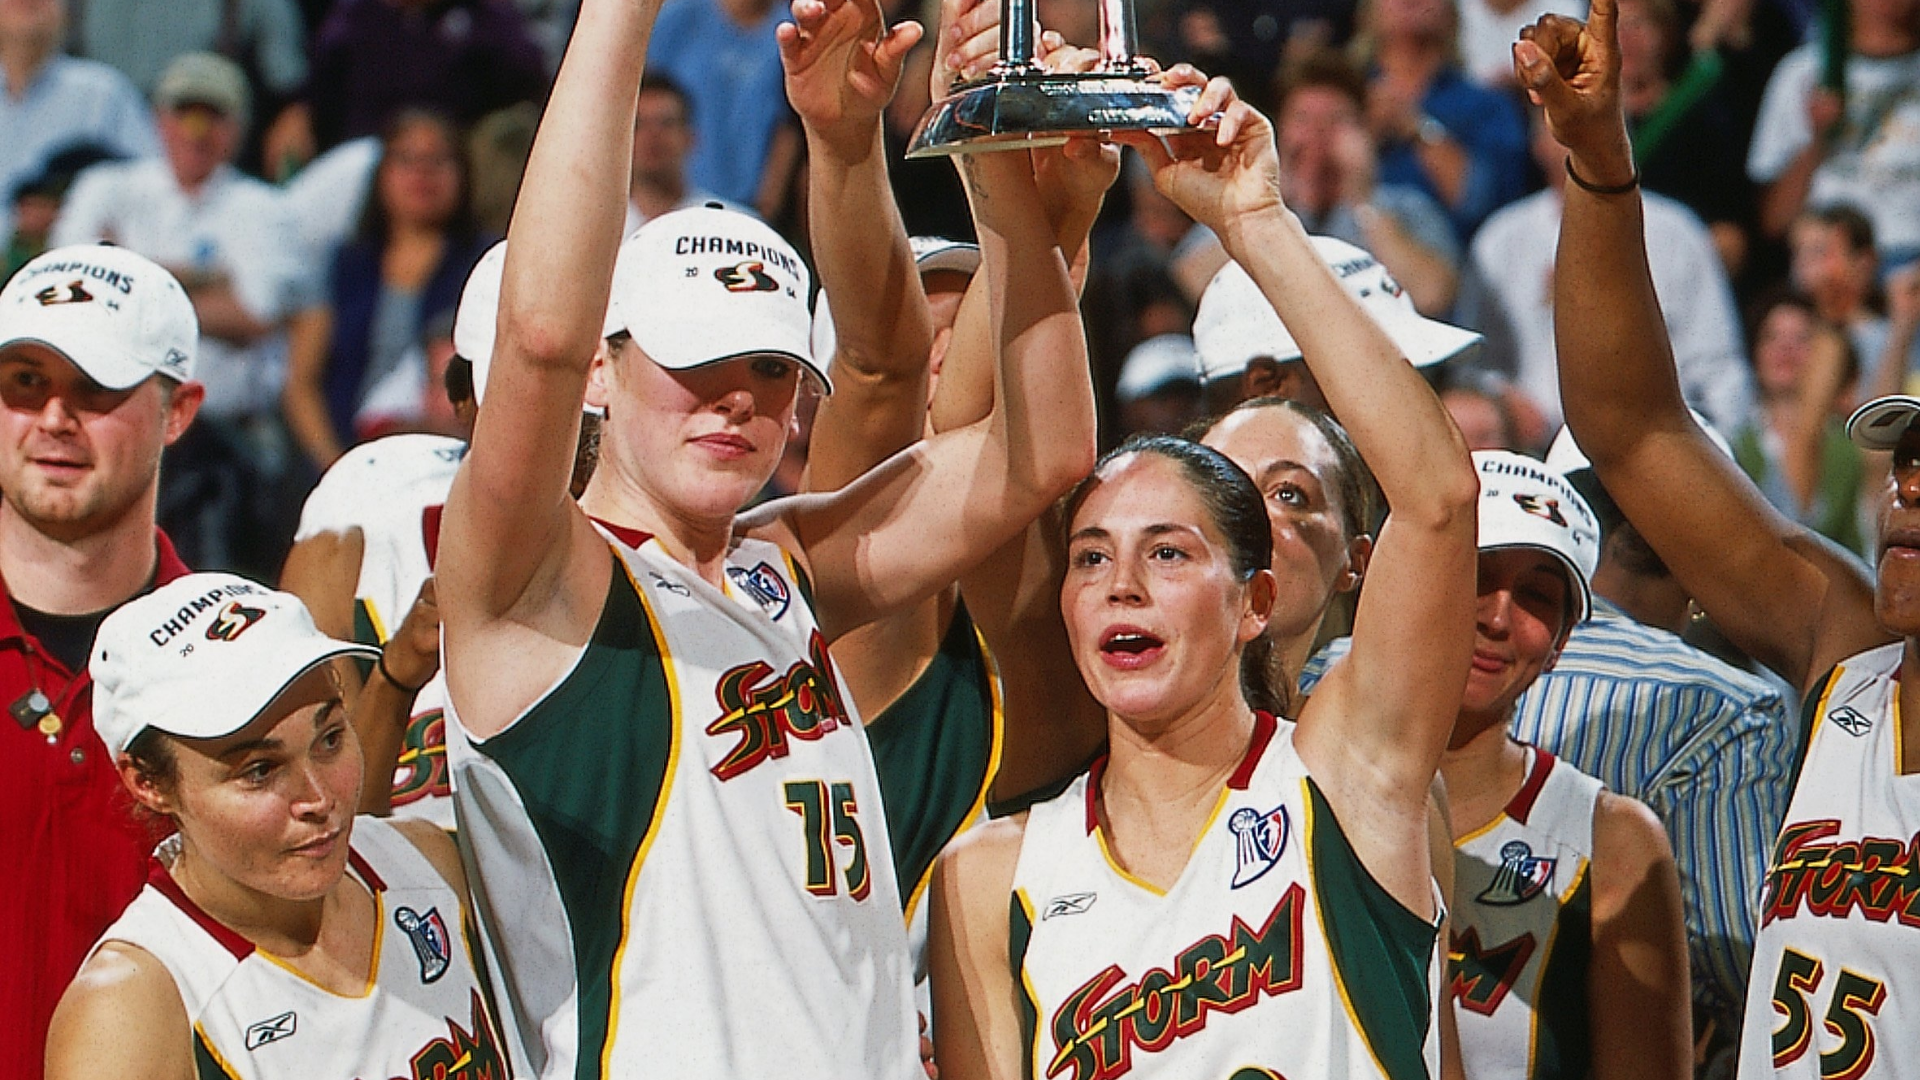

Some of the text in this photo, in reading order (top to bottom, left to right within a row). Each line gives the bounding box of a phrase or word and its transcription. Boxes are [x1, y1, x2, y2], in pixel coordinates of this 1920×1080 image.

[18, 261, 135, 295] AMPIONS
[675, 236, 800, 282] CHAMPIONS
[685, 267, 698, 277] 20
[179, 643, 195, 658] 20
[705, 627, 852, 782] STOM
[1046, 881, 1306, 1080] STORM
[1771, 945, 1888, 1080] 55
